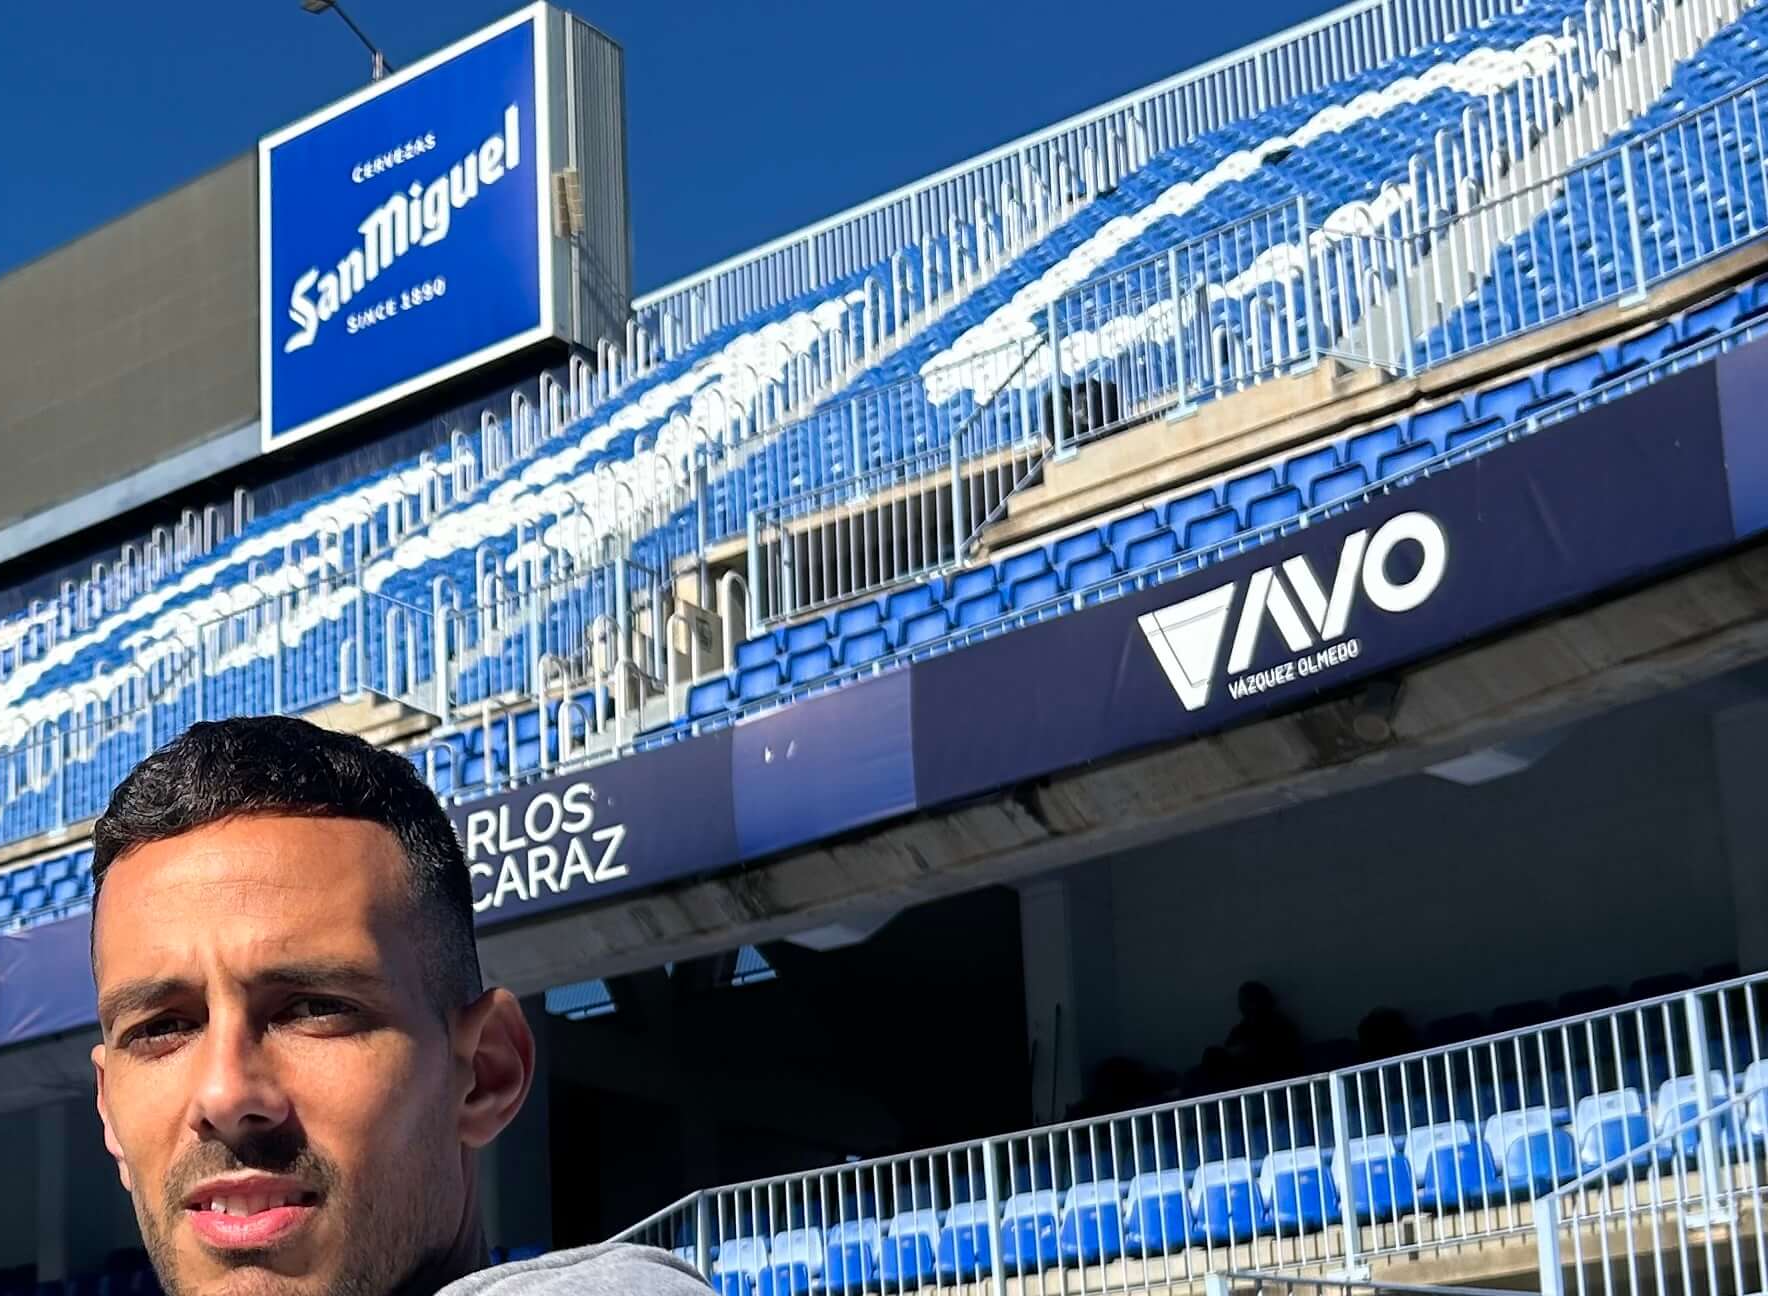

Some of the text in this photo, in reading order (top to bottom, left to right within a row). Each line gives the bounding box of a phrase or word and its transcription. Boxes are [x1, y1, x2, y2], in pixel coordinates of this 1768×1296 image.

[351, 132, 436, 183] CERVEZAS
[346, 276, 447, 334] SINCE 1890
[1298, 640, 1359, 677] OLMEDO
